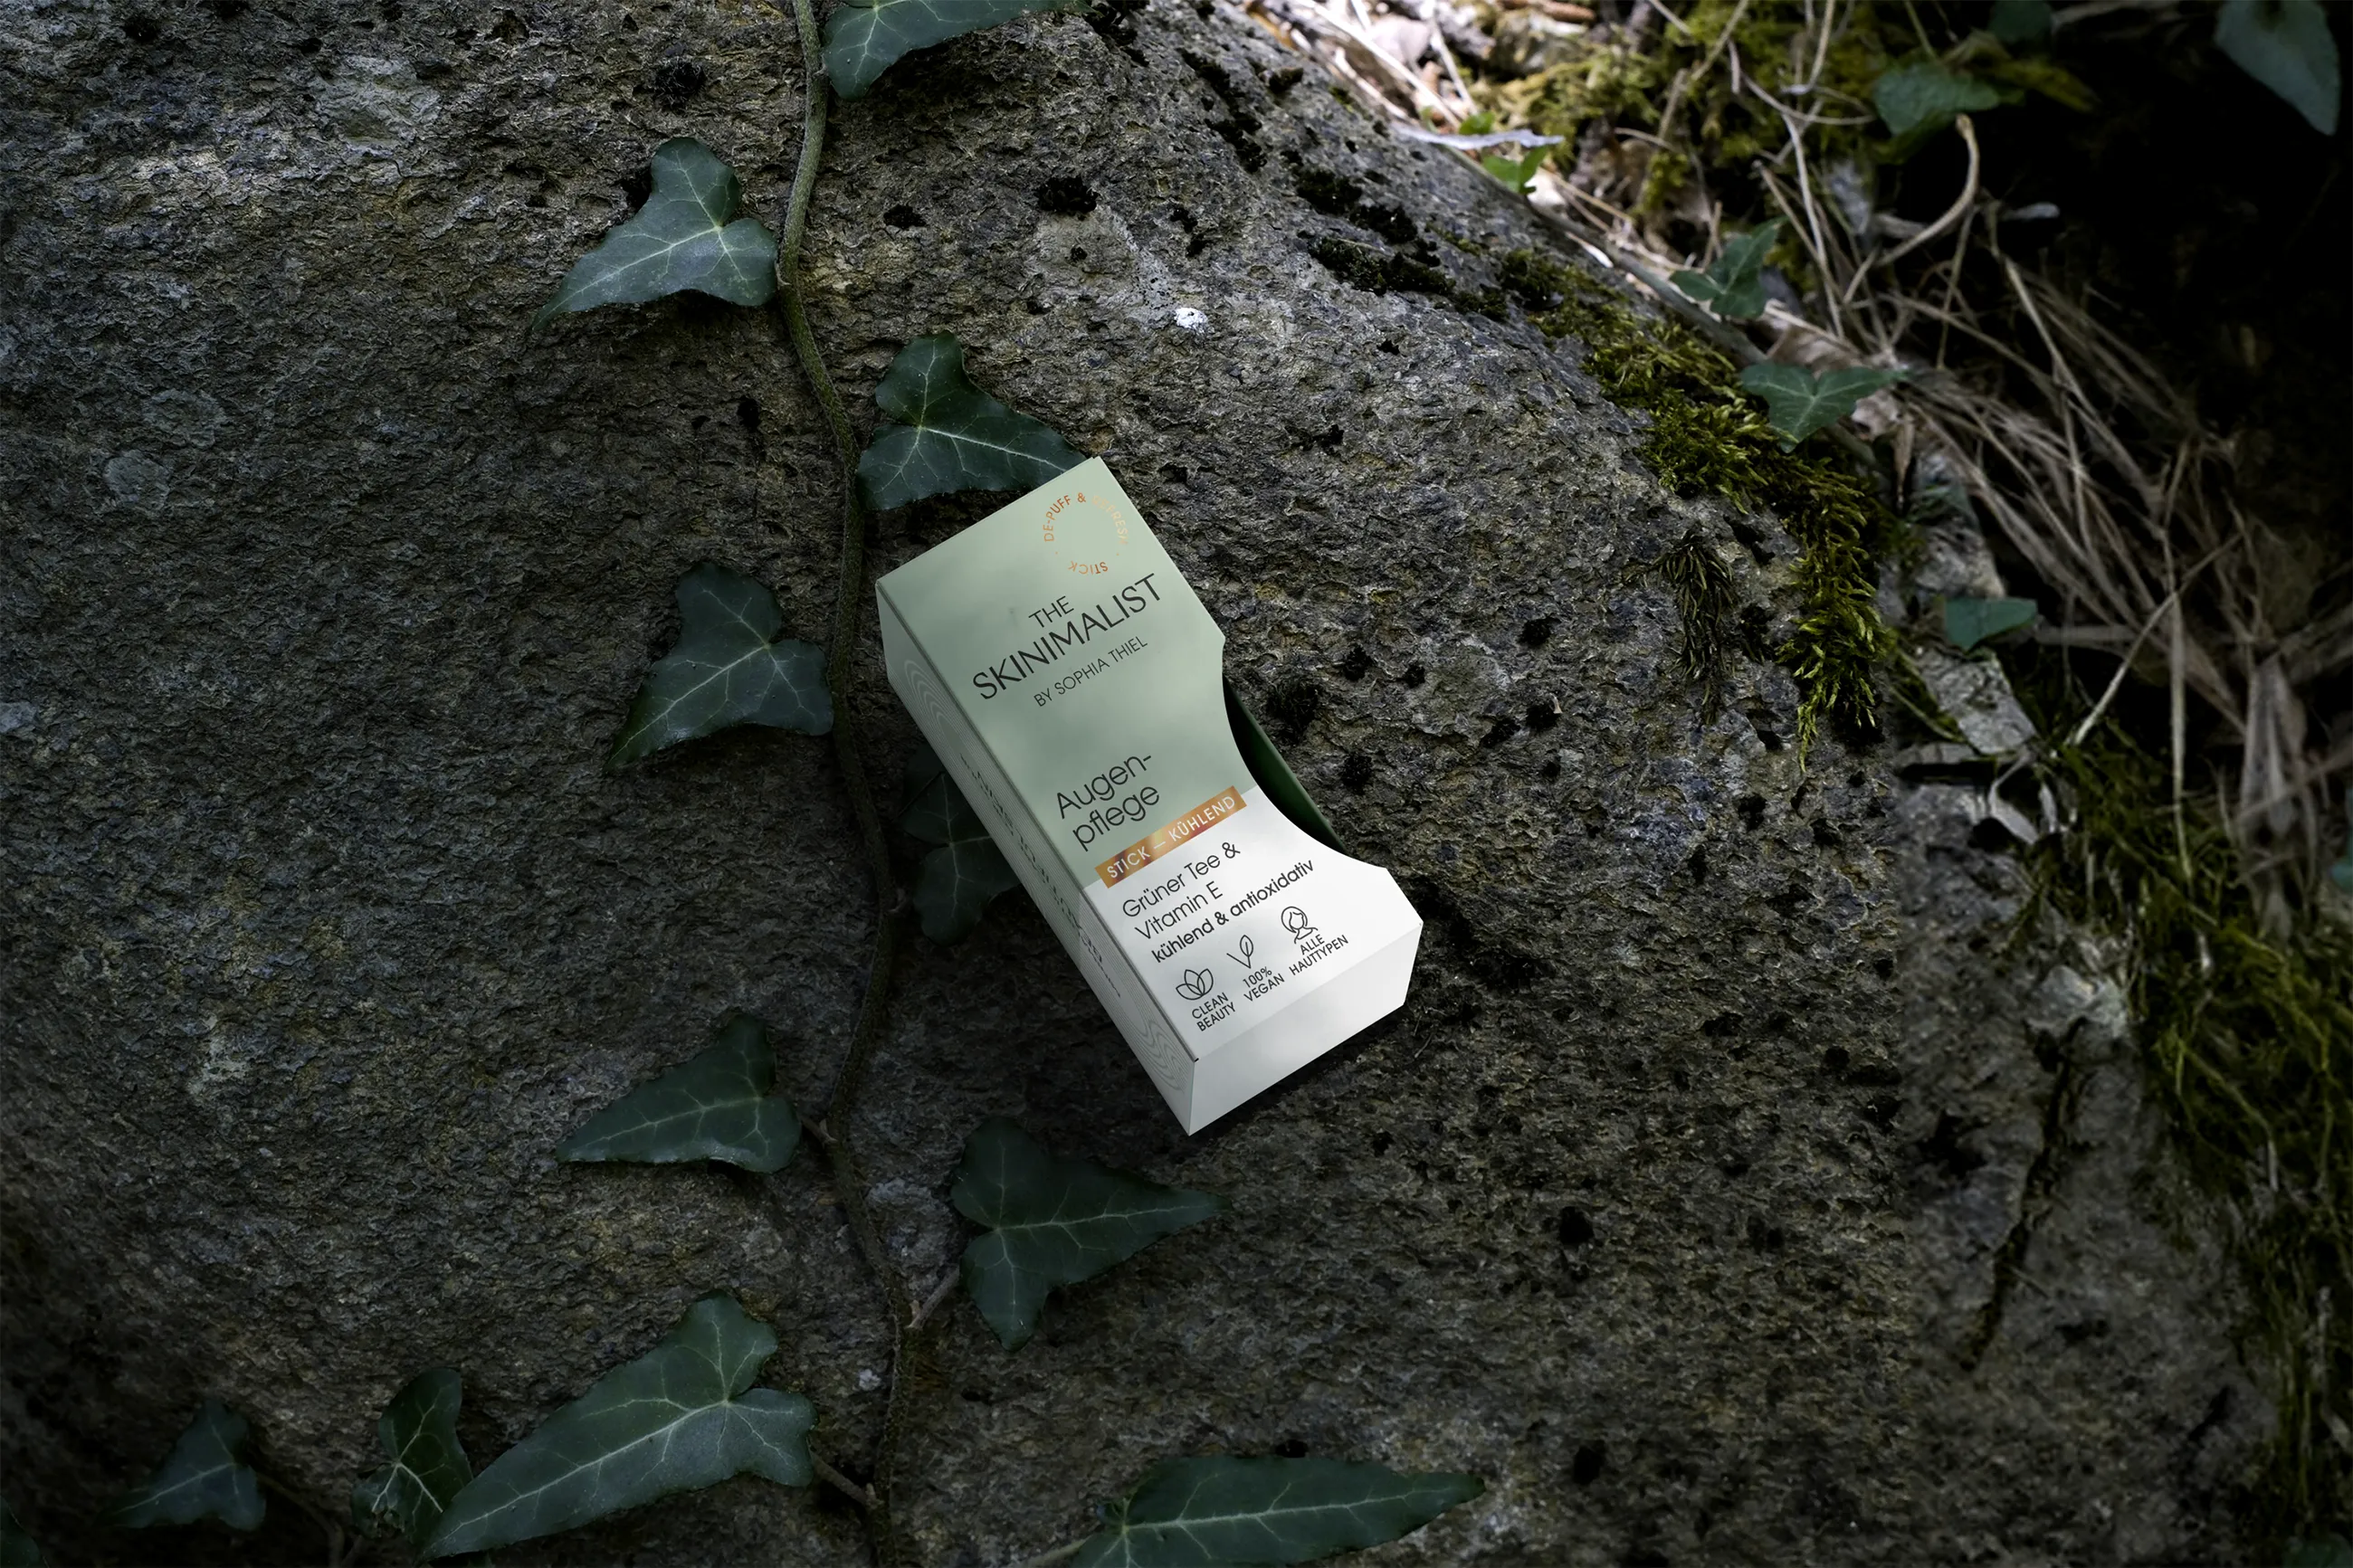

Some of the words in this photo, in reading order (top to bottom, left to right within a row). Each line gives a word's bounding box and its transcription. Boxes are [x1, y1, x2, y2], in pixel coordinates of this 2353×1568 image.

[1042, 494, 1072, 543] DE-PUFF
[1077, 492, 1086, 503] &
[1067, 560, 1109, 575] STICK
[972, 572, 1161, 700] SKINIMALIST
[1028, 595, 1075, 629] THE
[1033, 688, 1053, 708] BY
[1053, 658, 1110, 695] SOPHIA
[1107, 635, 1148, 663] THIEL
[1056, 755, 1152, 820] Augen-
[1072, 786, 1160, 852] pflege
[1107, 848, 1151, 879] STICK
[1168, 795, 1235, 842] KÜHLEND
[1122, 873, 1186, 917] Grüner
[1184, 854, 1221, 880] Tee
[1221, 841, 1241, 860] &
[1134, 895, 1202, 940] Vitamin
[1205, 881, 1224, 900] E
[1150, 917, 1215, 964] kühlend
[1214, 912, 1230, 926] &
[1229, 860, 1314, 917] antioxidativ
[1288, 935, 1349, 976] HAUTTYPEN
[1300, 936, 1326, 955] ALLE
[1242, 965, 1273, 988] 100%
[1243, 973, 1285, 1002] VEGAN
[1191, 992, 1229, 1020] CLEAN
[1196, 1001, 1236, 1032] BEAUTY
